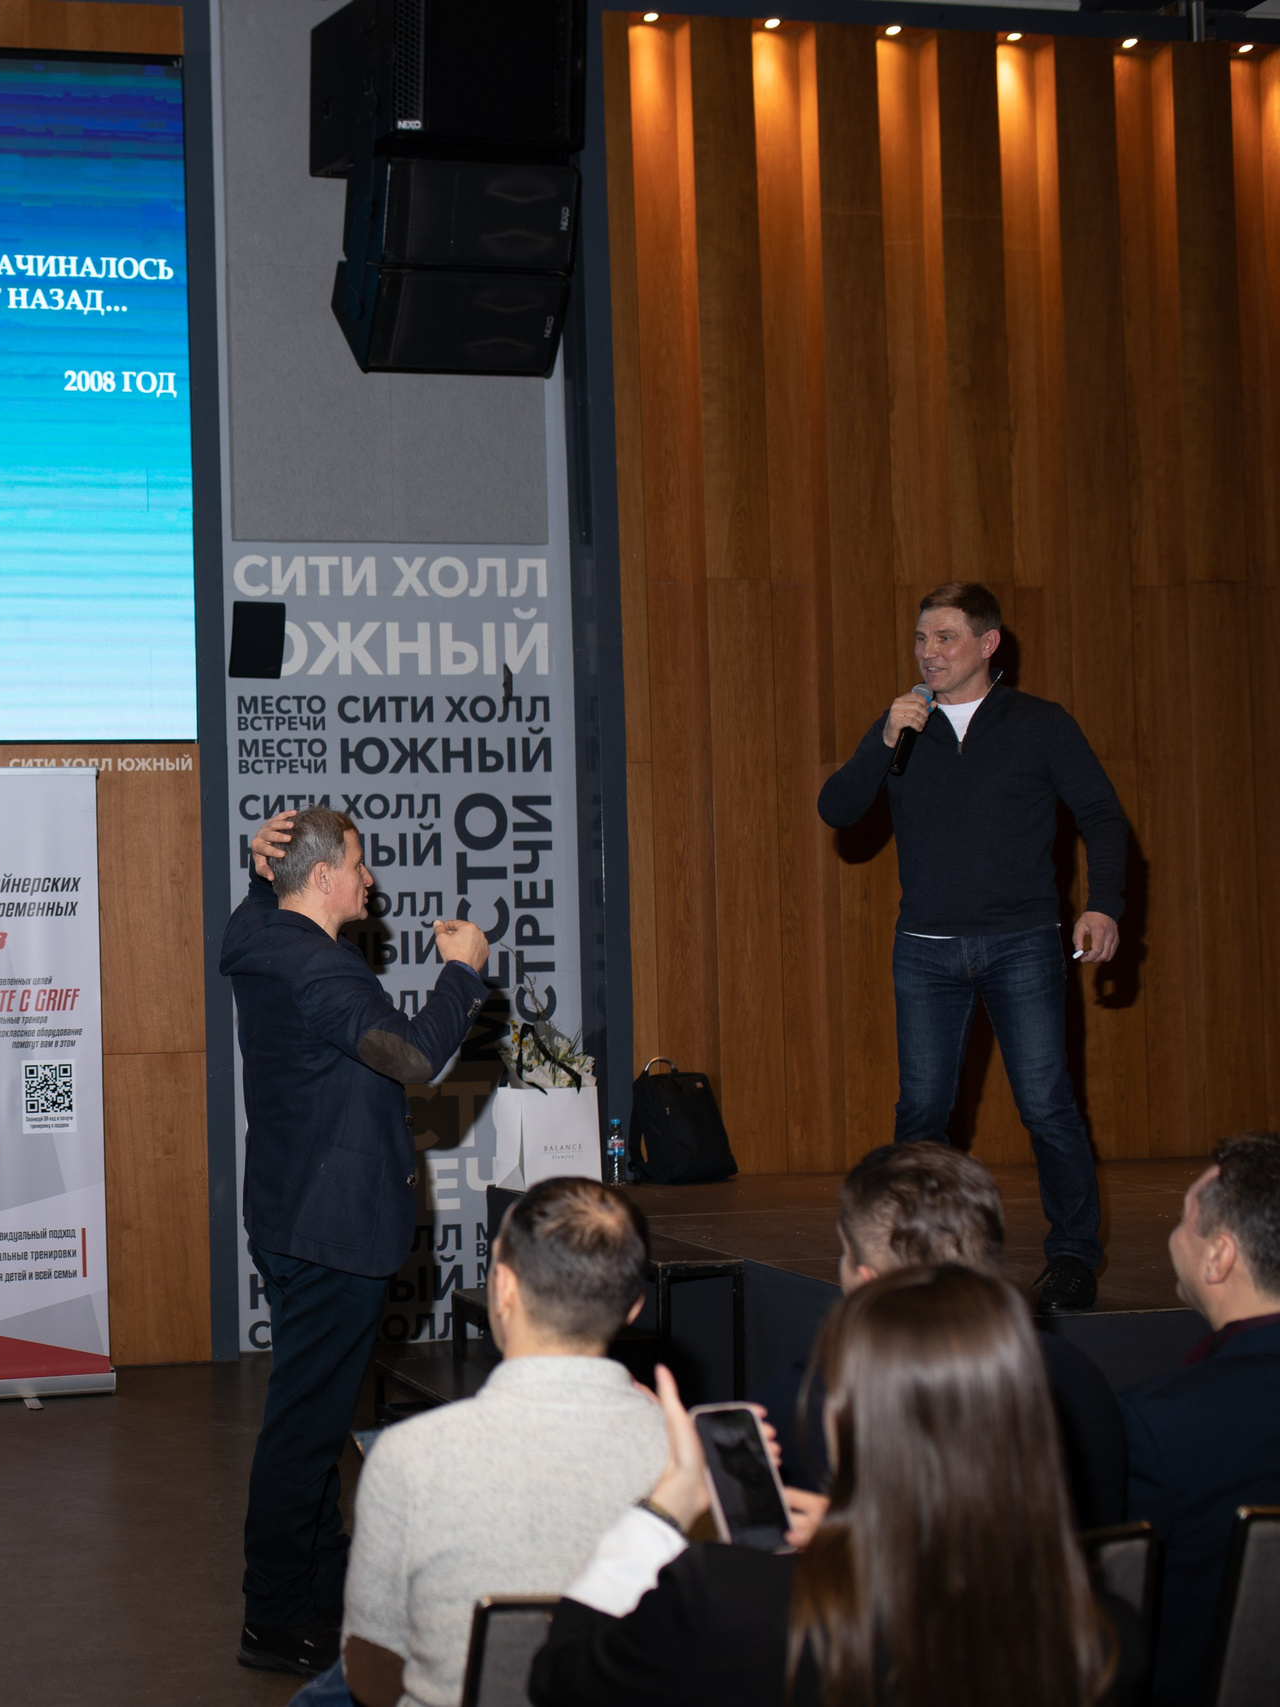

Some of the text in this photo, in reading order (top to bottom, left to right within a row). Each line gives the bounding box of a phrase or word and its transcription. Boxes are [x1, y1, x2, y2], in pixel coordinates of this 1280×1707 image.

[398, 120, 421, 129] NEXO
[560, 206, 569, 231] NEXO
[8, 288, 128, 316] НАЗАД...
[543, 315, 554, 338] NEXO
[64, 370, 177, 398] 2008 ГОД
[233, 555, 547, 598] СИТИ ХОЛЛ
[237, 695, 326, 715] МЕСТО
[337, 696, 551, 723] СИТИ ХОЛЛ
[237, 716, 326, 731] ВСТРЕЧИ
[239, 738, 327, 757] МЕСТО
[341, 727, 552, 775] ЮЖНЫЙ
[118, 755, 192, 771] ЮЖНЫЙ
[239, 759, 327, 774] ВСТРЕЧИ
[341, 793, 441, 820] ХОЛЛ
[371, 891, 444, 918] ОЛЛ
[512, 795, 557, 1023] СТРЕЧИ
[32, 975, 53, 985] целей
[19, 990, 31, 1012] С
[34, 988, 80, 1011] GRIFF
[21, 1015, 48, 1025] тренера
[37, 1028, 83, 1038] оборудование
[12, 1039, 75, 1050] помогут вам в этом
[544, 1143, 582, 1151] BALANCE
[49, 1229, 76, 1239] подход
[31, 1249, 77, 1261] тренировки
[5, 1270, 26, 1283] детей
[28, 1272, 33, 1280] и
[35, 1269, 52, 1280] всей
[54, 1270, 77, 1279] семьи
